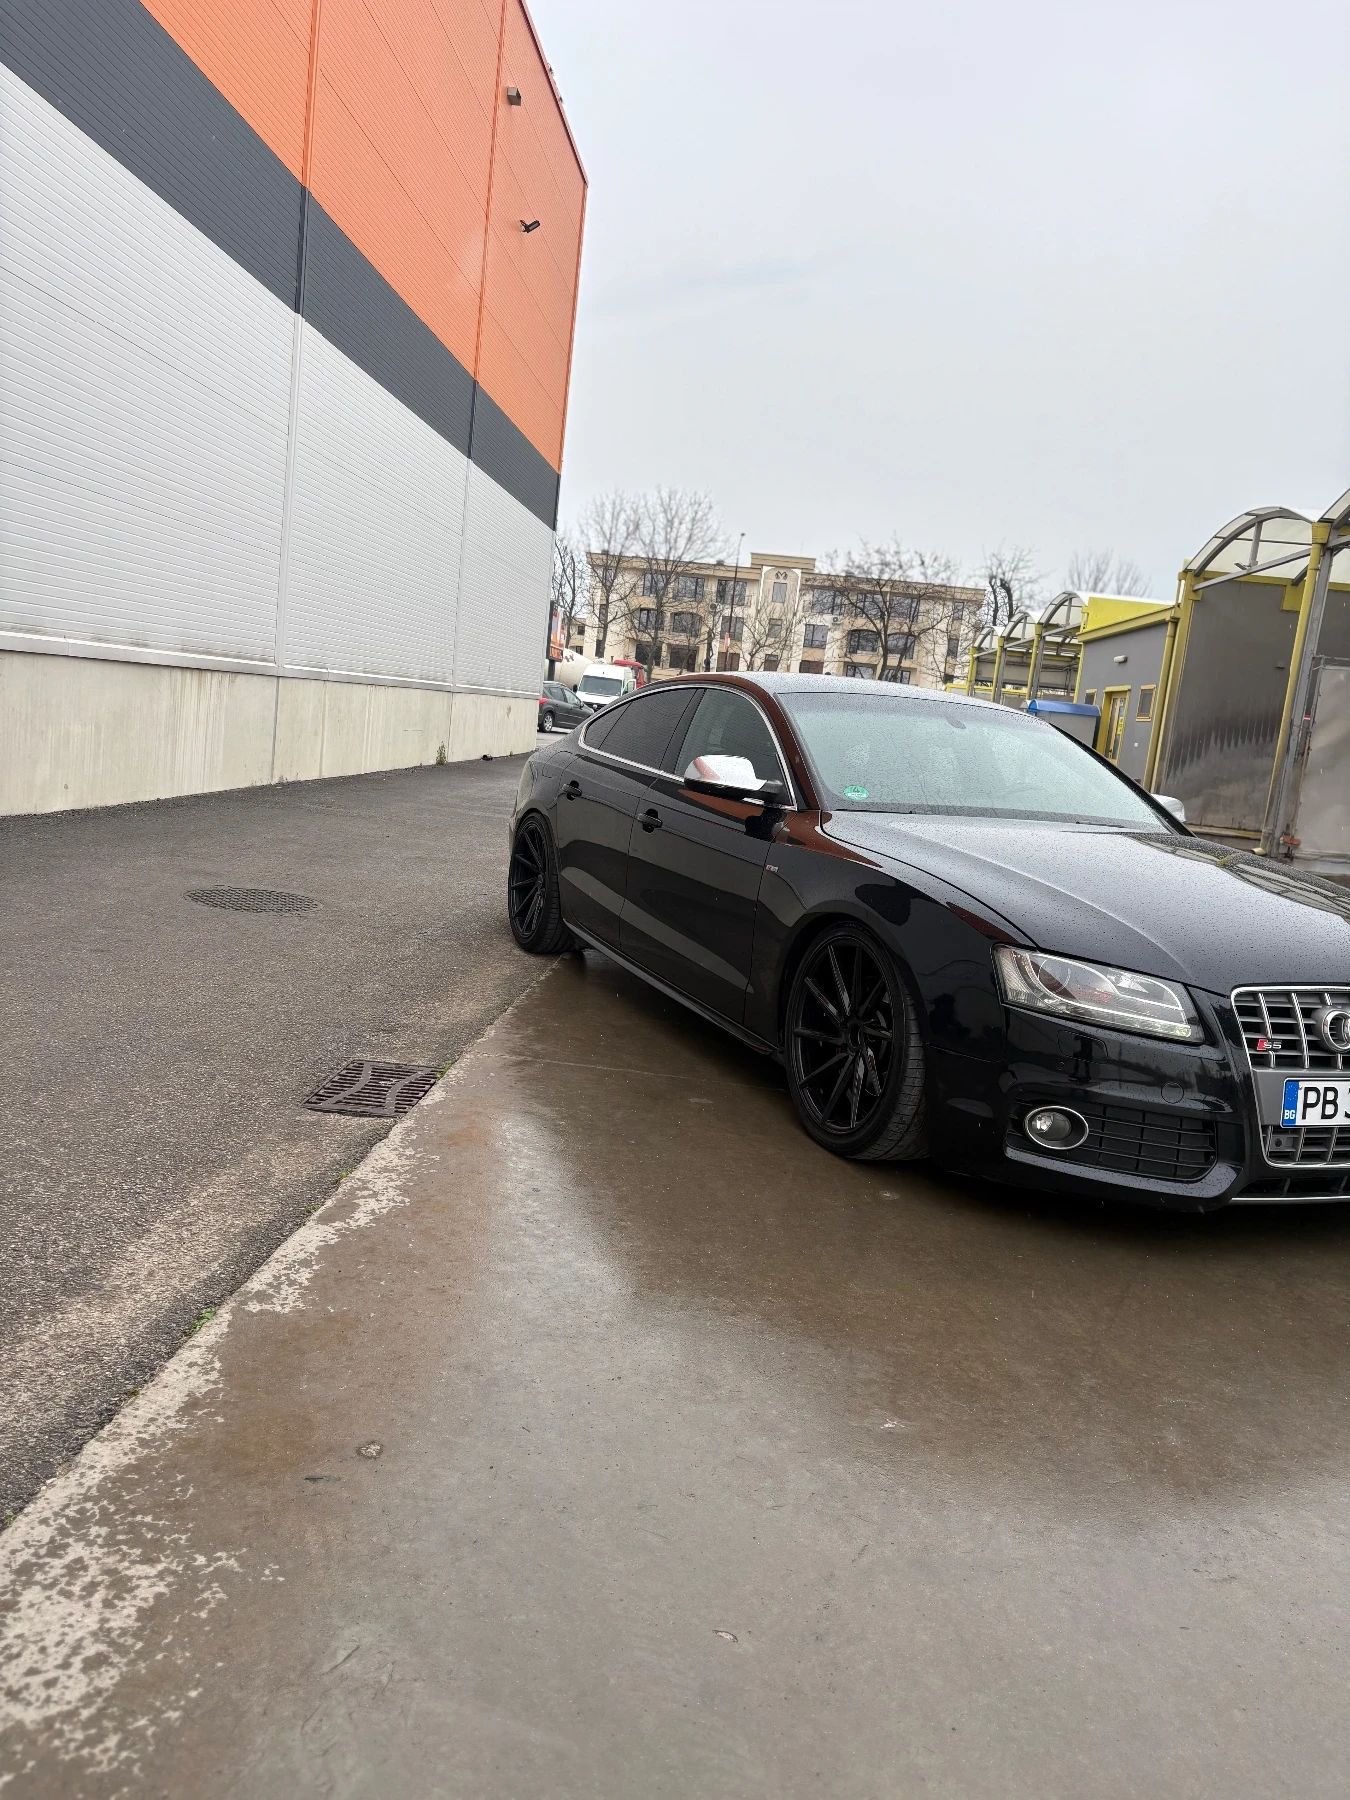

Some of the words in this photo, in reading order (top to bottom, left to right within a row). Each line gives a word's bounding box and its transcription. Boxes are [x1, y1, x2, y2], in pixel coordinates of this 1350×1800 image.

[1263, 1041, 1282, 1049] S5
[1301, 1086, 1339, 1120] PB
[1284, 1109, 1296, 1120] BG
